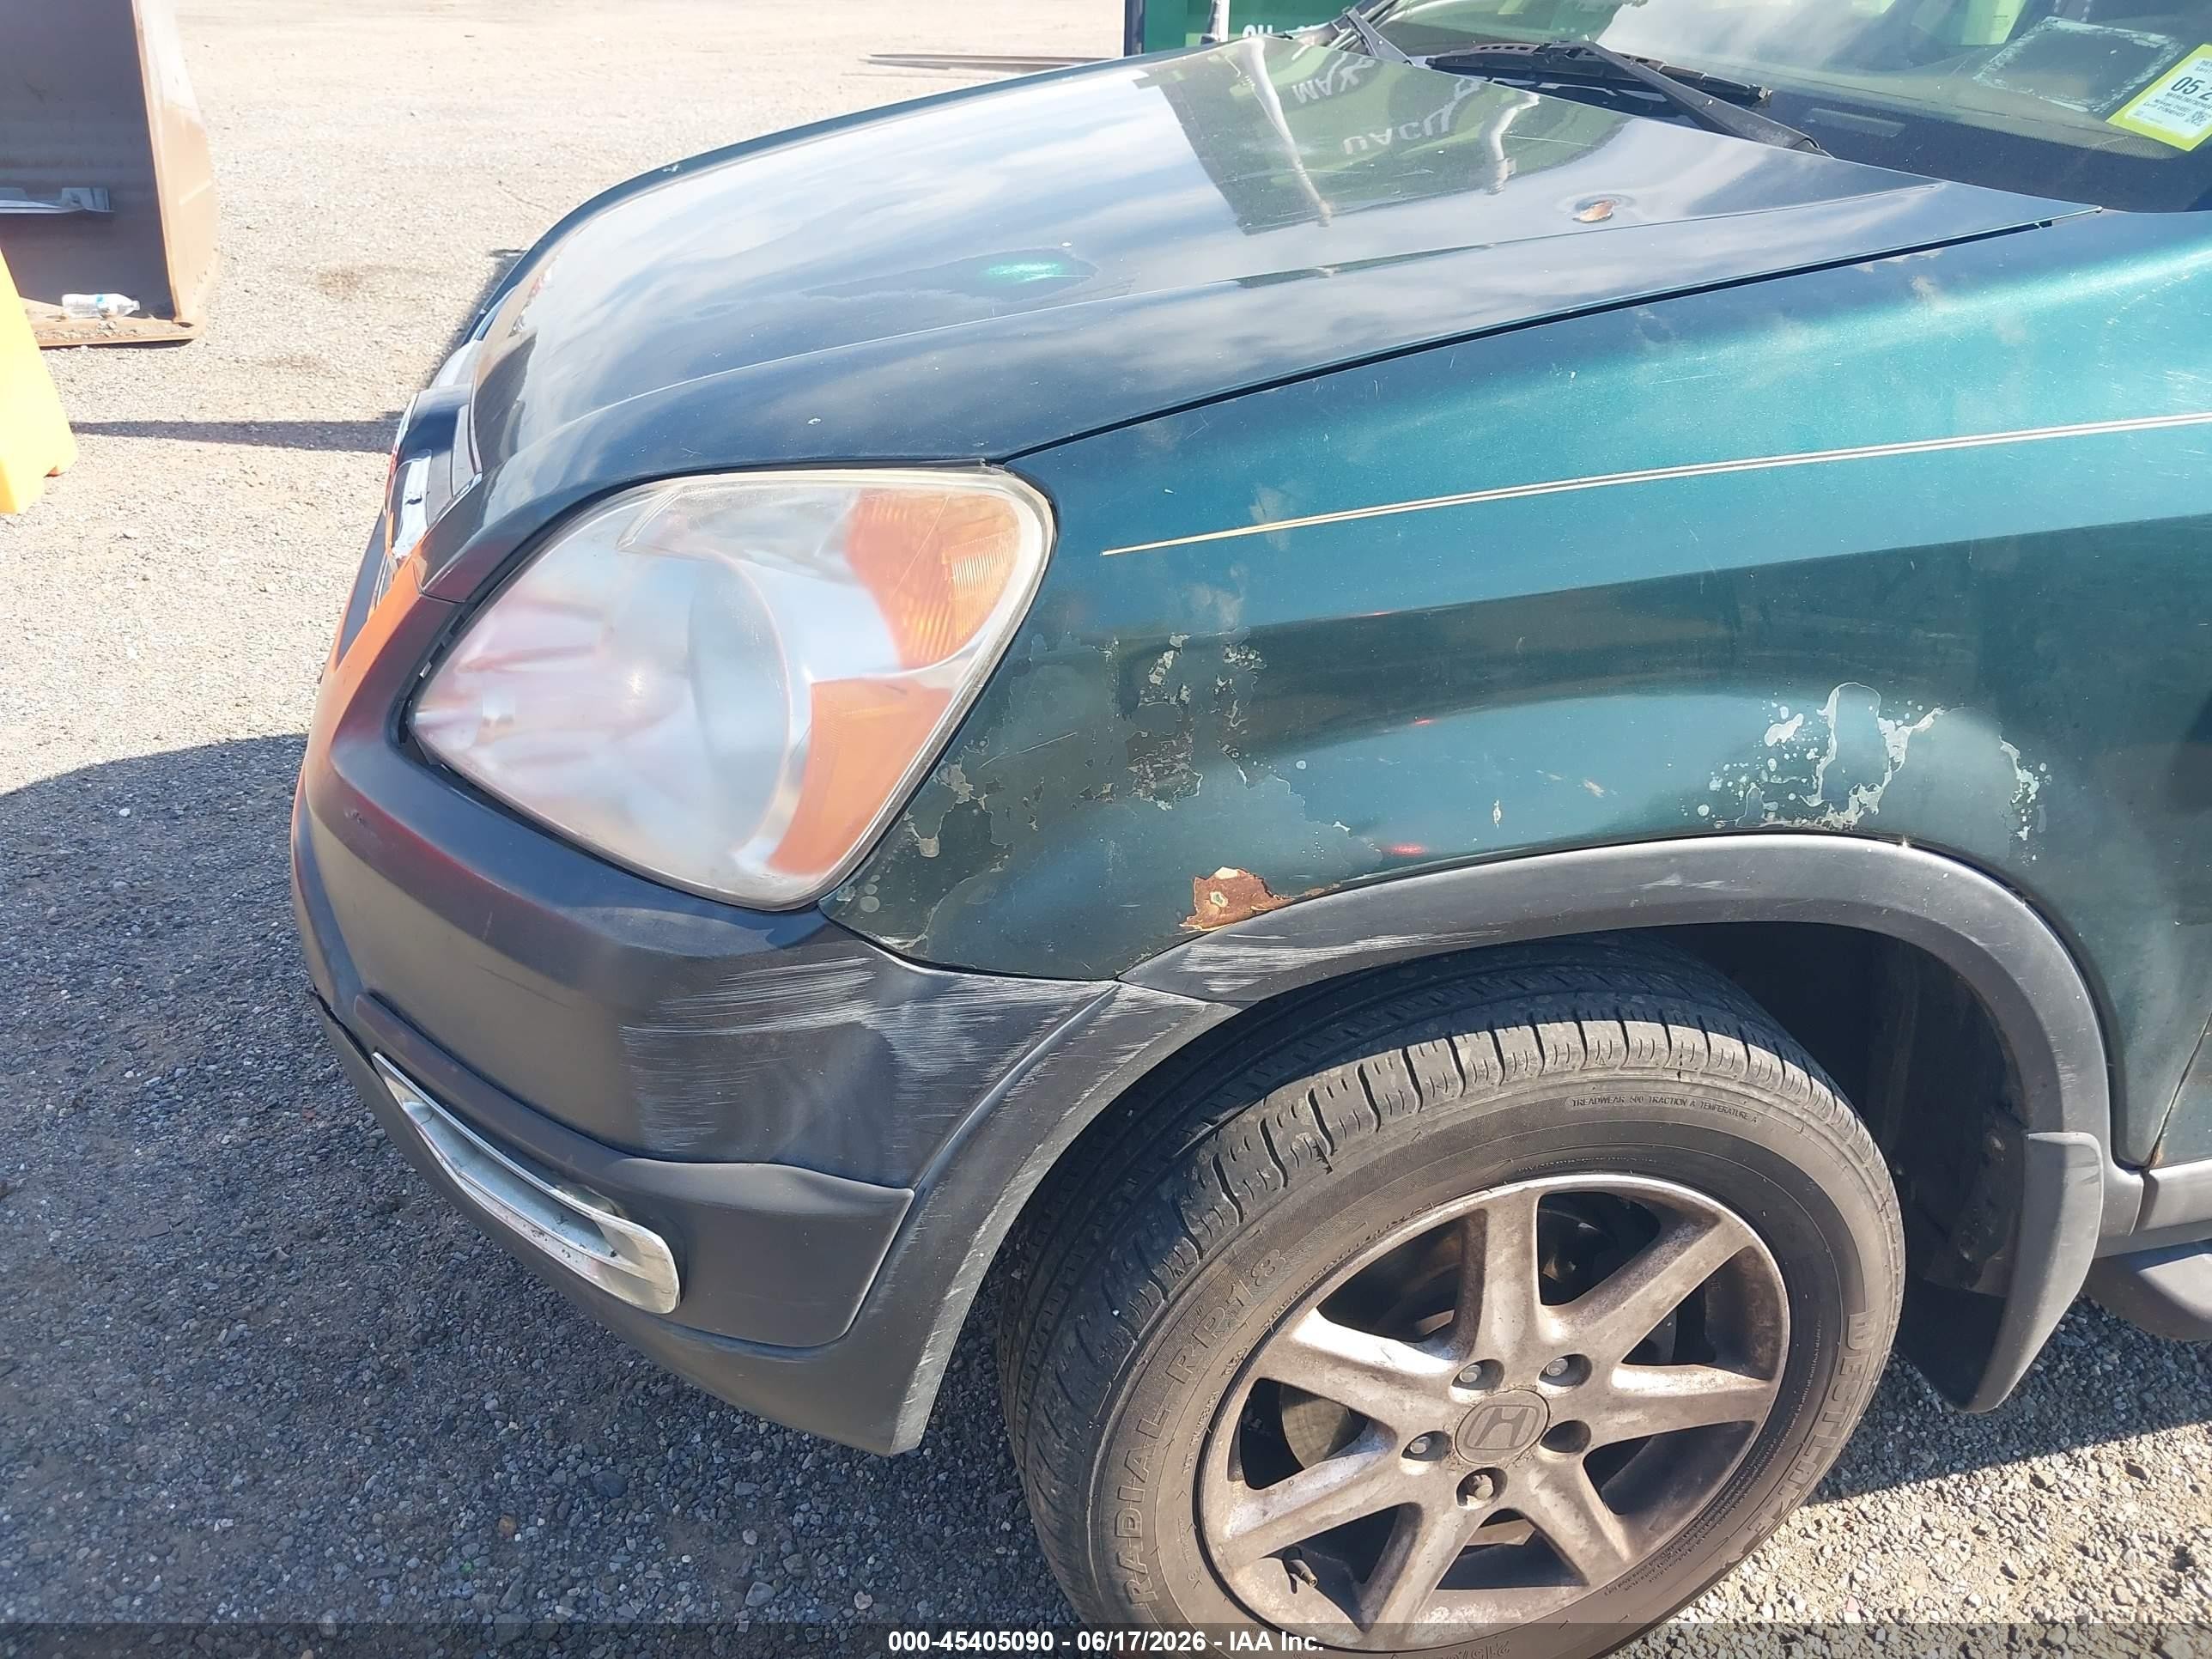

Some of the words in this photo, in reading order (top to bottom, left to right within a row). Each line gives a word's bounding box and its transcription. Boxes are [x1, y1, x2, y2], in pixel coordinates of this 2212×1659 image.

[1572, 1096, 1625, 1108] TREADWEAR
[1648, 1096, 1687, 1107] TRACTION
[1699, 1101, 1749, 1121] TEMPERATURE
[1115, 1407, 1170, 1607] RADIAL
[1747, 1310, 1876, 1534] WESTLAKE
